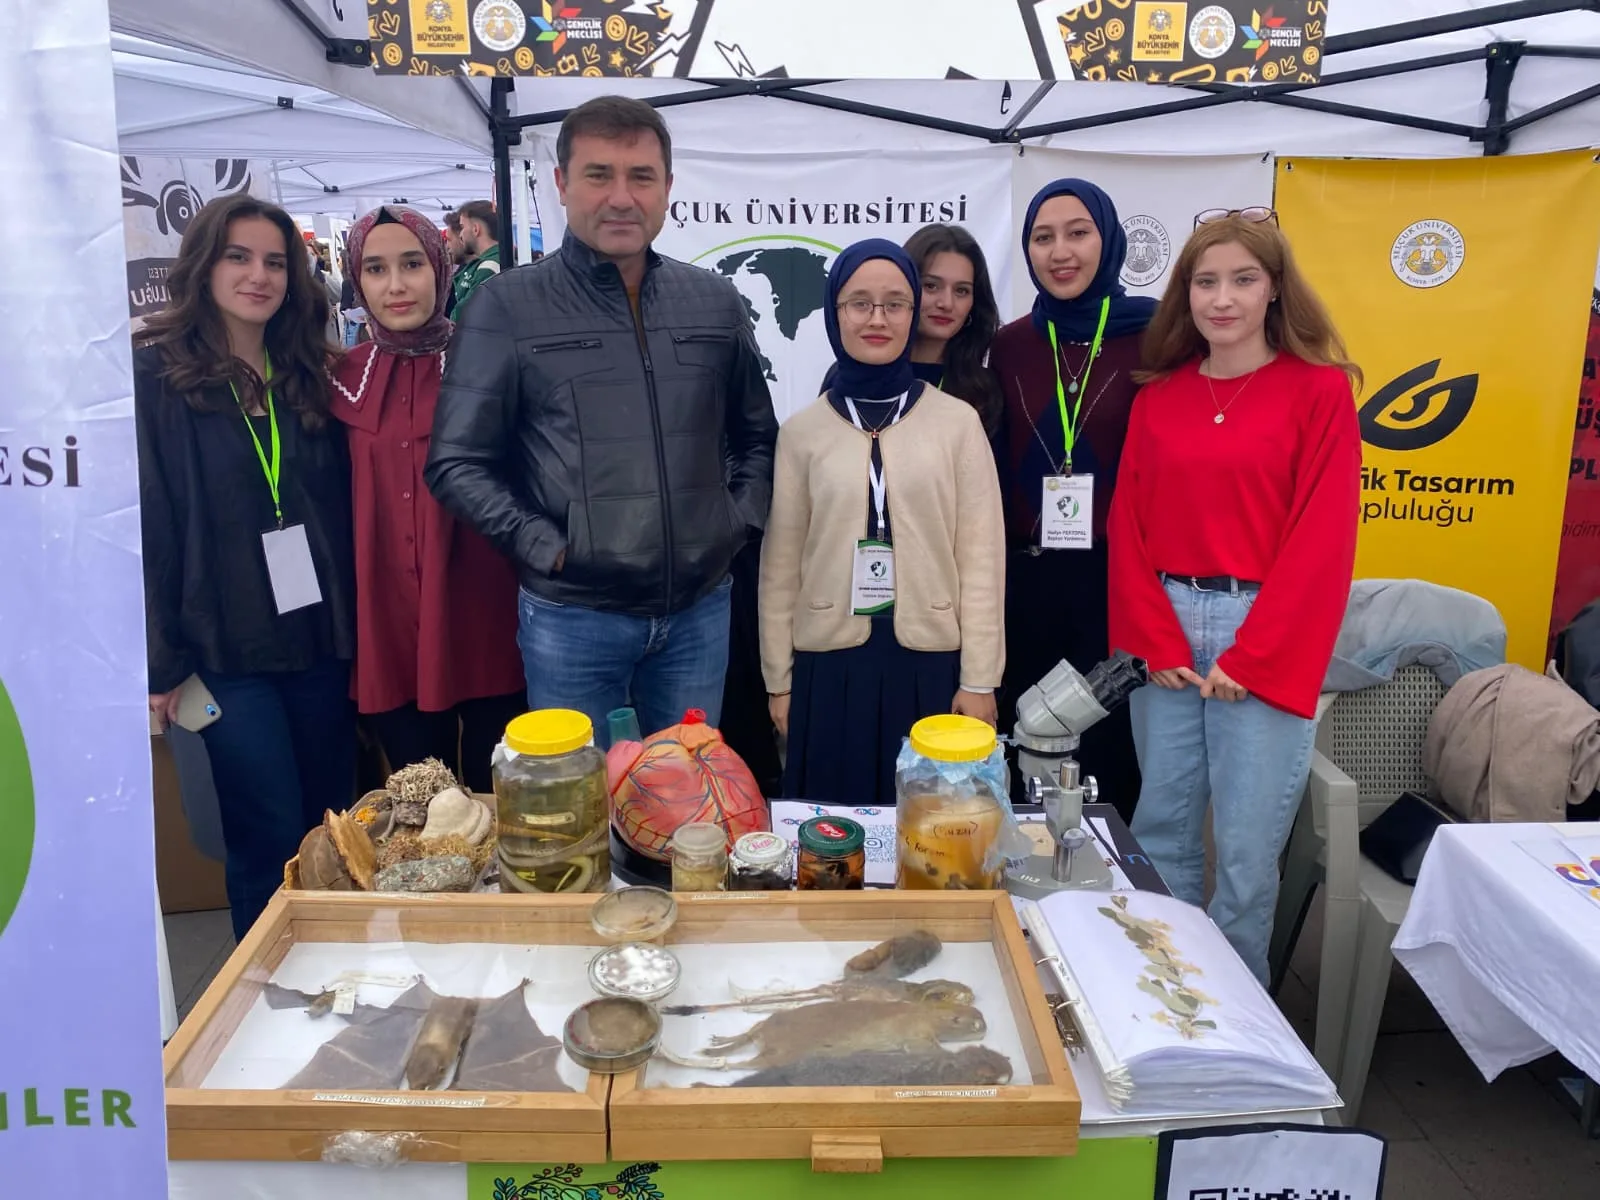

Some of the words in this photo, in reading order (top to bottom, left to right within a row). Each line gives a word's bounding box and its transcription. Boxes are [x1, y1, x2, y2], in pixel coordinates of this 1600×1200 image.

[746, 194, 968, 225] ÜNİVERSİTESİ
[1394, 469, 1515, 496] Tasarım
[1359, 497, 1474, 528] pluluğu
